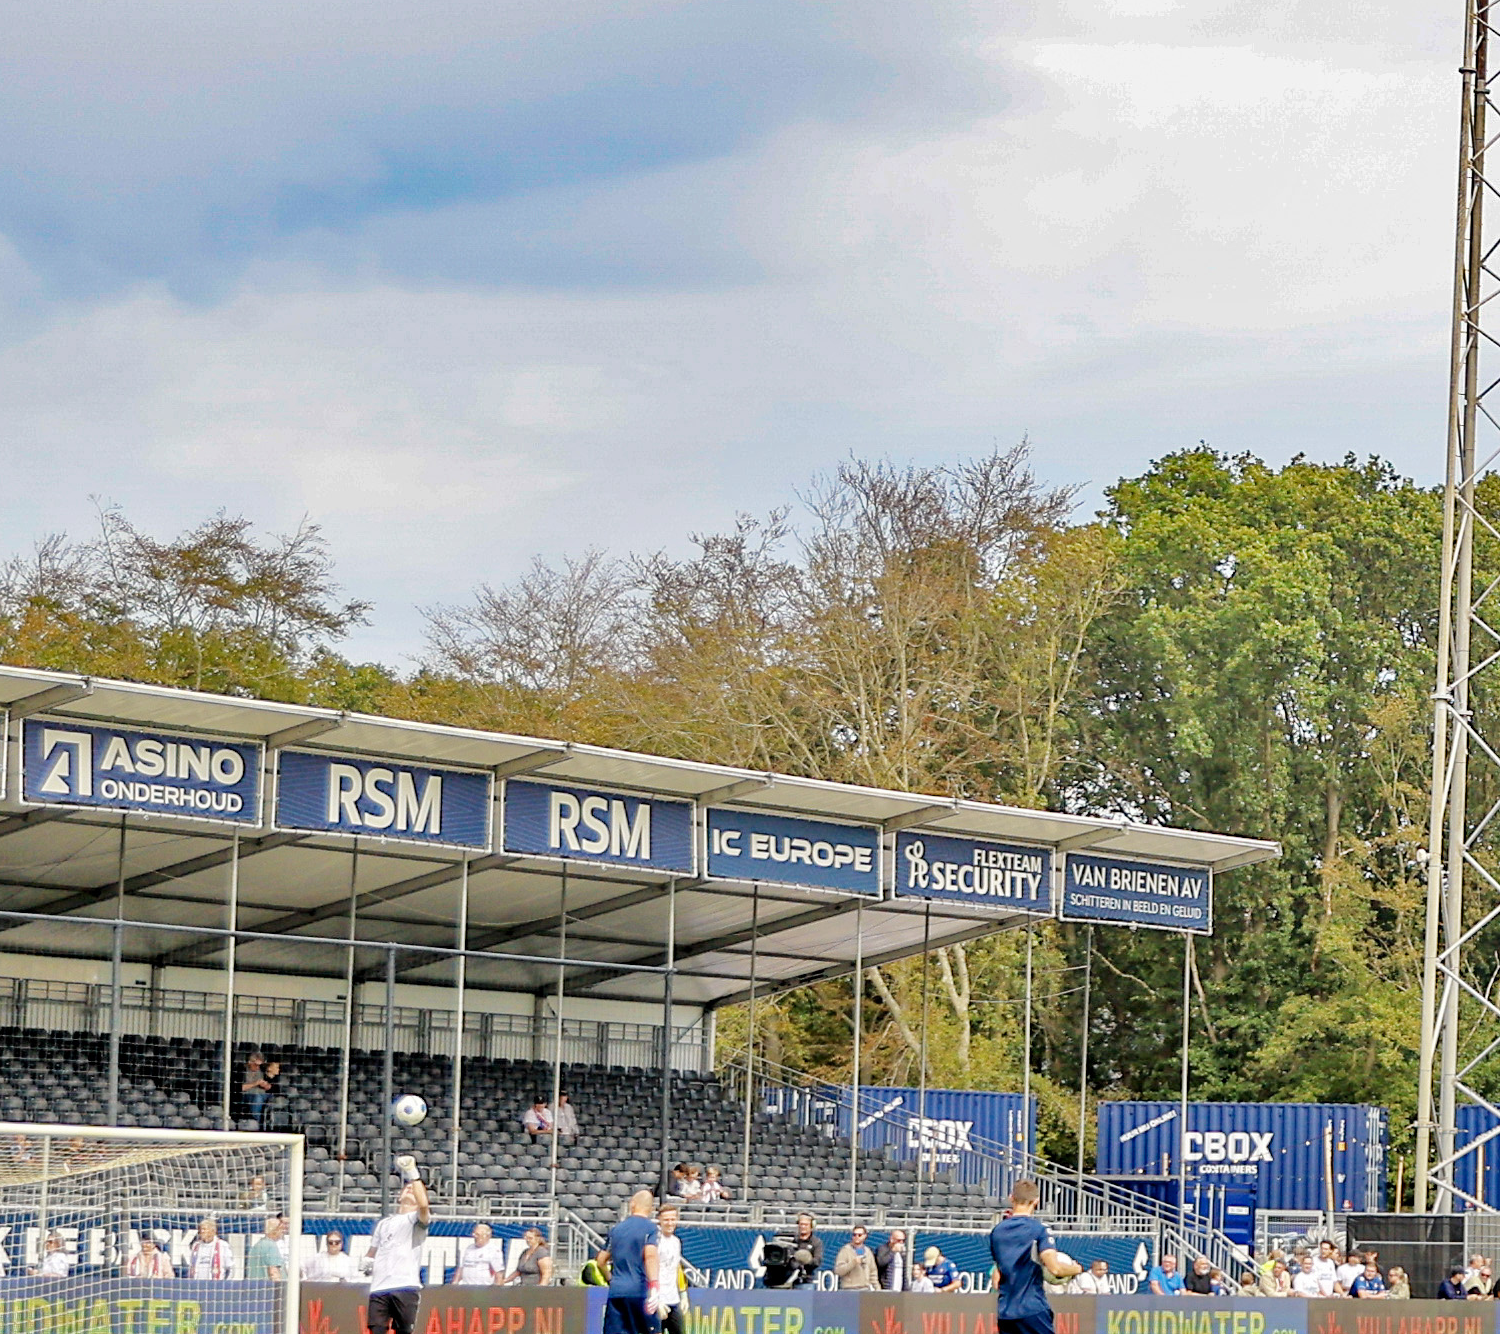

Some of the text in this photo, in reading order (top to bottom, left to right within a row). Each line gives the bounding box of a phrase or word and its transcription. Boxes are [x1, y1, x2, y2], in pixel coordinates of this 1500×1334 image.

[101, 737, 244, 786] ASINO
[101, 779, 243, 813] ONDERHOUD
[328, 762, 442, 834] RSM
[550, 791, 651, 860] RSM
[712, 829, 873, 873] IC EUROPE
[974, 849, 1042, 874] FLEXTEAM
[932, 862, 1042, 901] SECURITY
[1072, 863, 1202, 899] VAN BRIENEN AV
[1070, 893, 1202, 919] SCHITTEREN IN BEELD EN GELUID
[1184, 1132, 1274, 1161] CBOX
